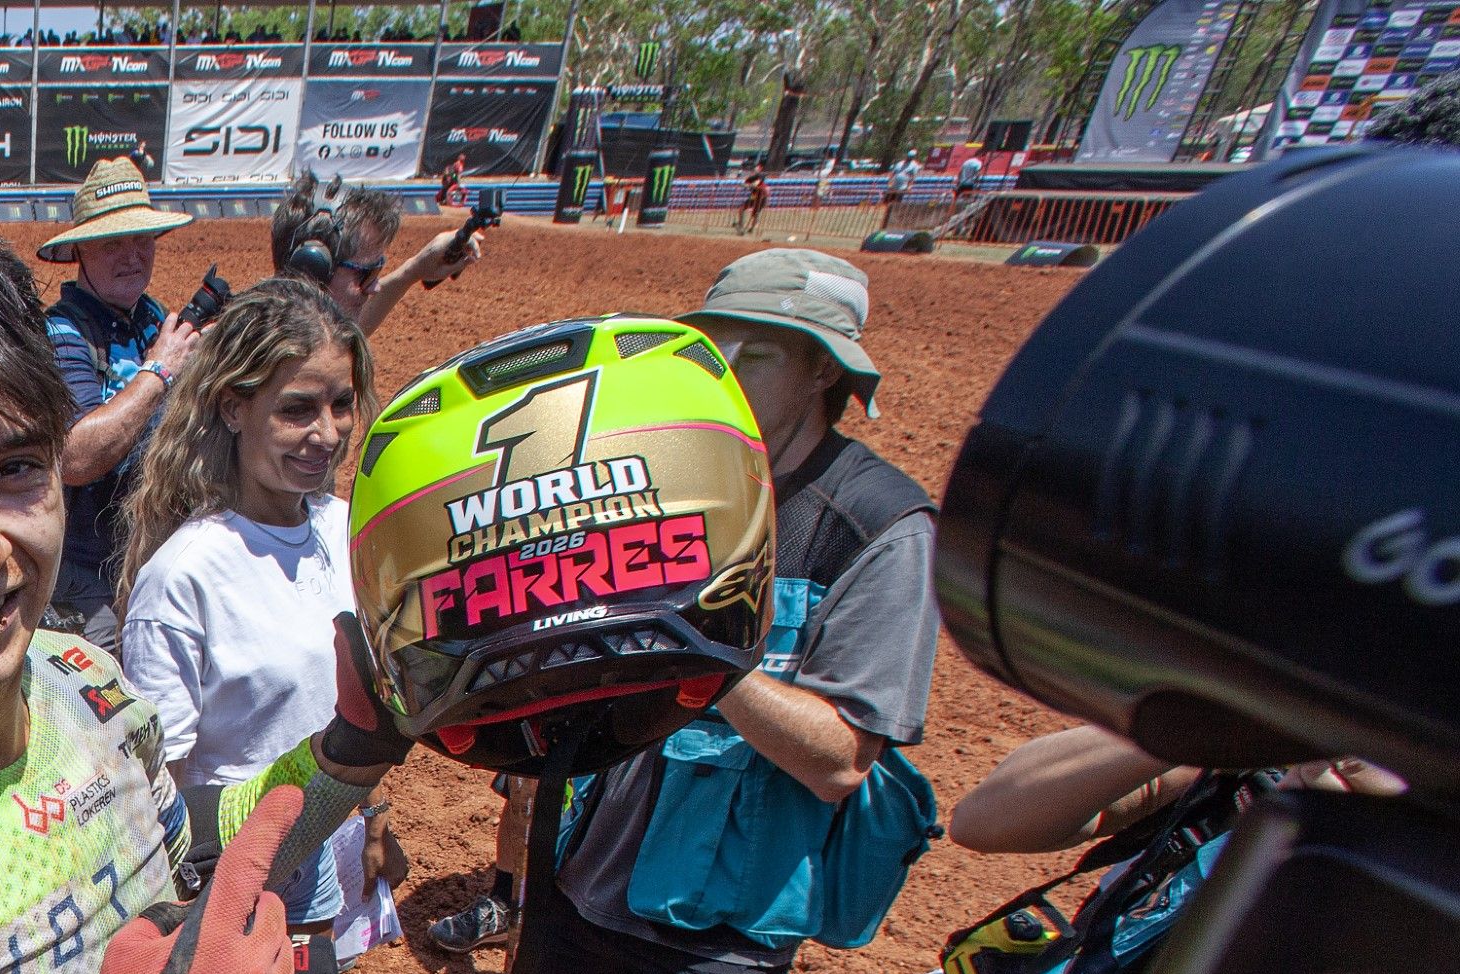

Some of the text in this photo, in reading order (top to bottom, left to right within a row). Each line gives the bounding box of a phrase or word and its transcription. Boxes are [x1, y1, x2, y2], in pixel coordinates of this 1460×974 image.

[183, 125, 282, 157] SIDI
[322, 122, 398, 139] FOLLOW US
[96, 181, 142, 198] SHIMANO
[471, 366, 602, 488] 1
[446, 458, 650, 536] WORLD
[449, 489, 666, 563] CHAMPION
[519, 530, 588, 561] 2026
[420, 515, 712, 640] FARRES
[532, 605, 609, 632] LIVING
[69, 774, 111, 812] PLASTICS
[77, 787, 117, 827] LOKEREN
